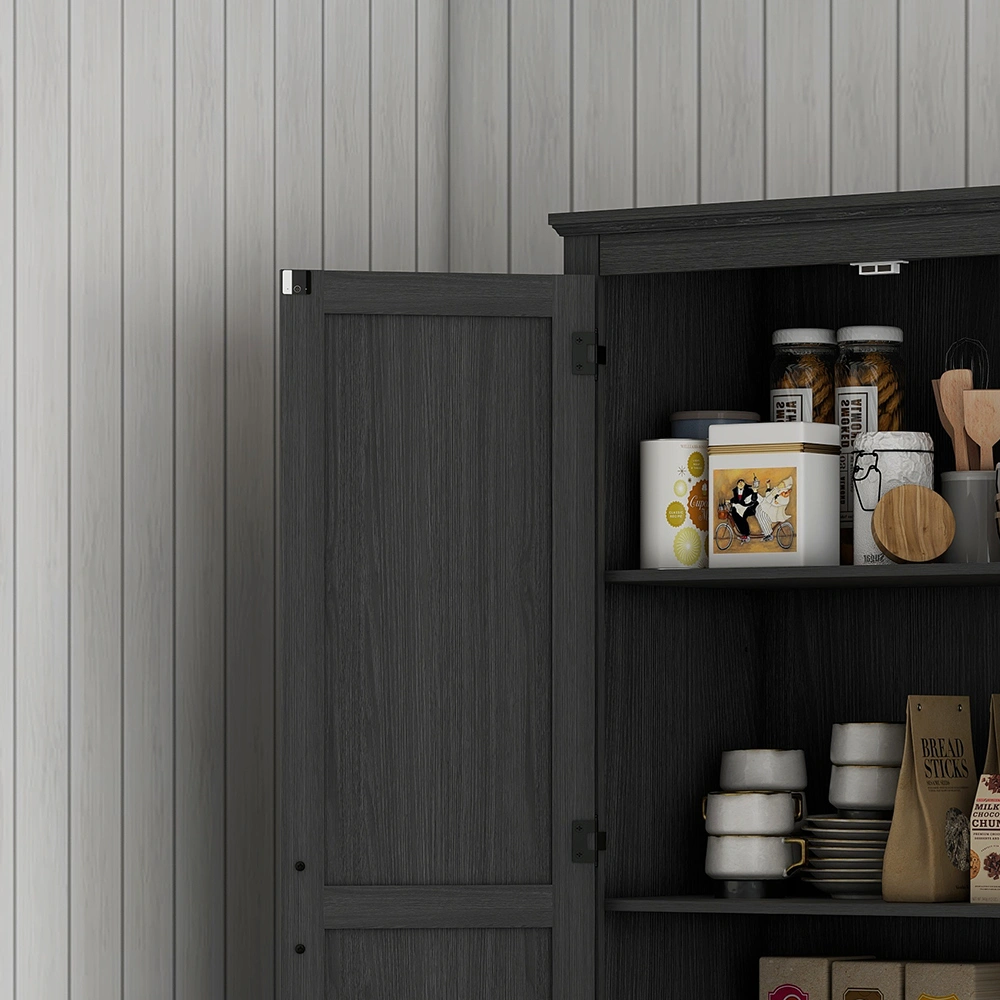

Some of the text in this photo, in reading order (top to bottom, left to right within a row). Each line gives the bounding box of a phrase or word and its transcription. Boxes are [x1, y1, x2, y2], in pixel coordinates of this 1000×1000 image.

[921, 738, 964, 758] BREAD
[923, 758, 969, 779] STICKS
[974, 803, 1000, 811] MILK
